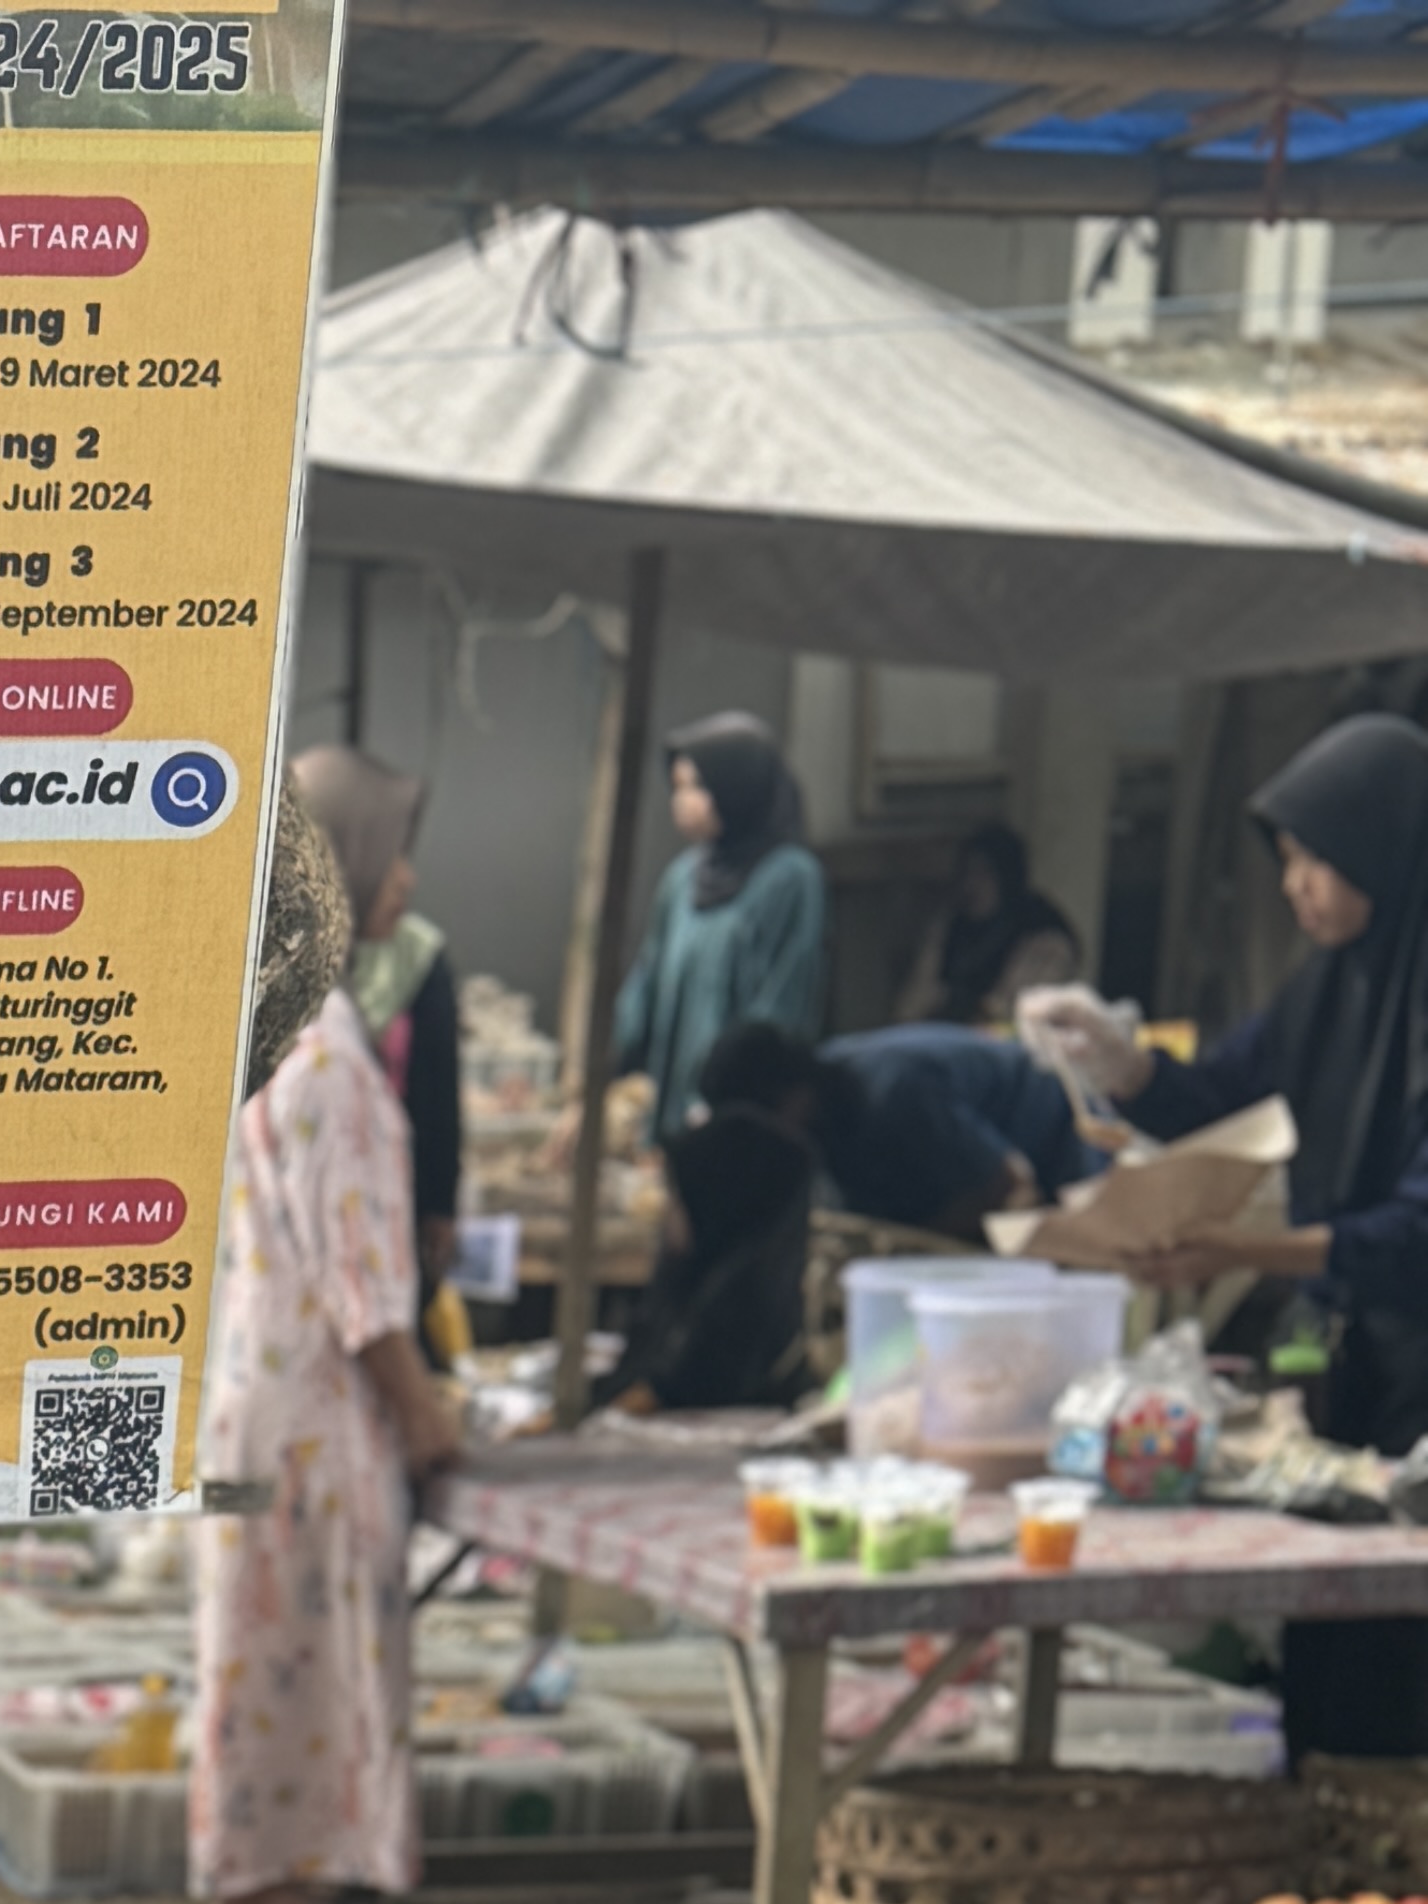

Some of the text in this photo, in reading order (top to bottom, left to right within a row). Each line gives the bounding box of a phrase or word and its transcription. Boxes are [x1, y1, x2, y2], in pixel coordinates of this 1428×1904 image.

[85, 304, 100, 335] 1
[30, 360, 129, 388] Maret
[137, 360, 221, 388] 2024
[76, 428, 100, 458] 2
[3, 483, 61, 511] Juli
[69, 483, 152, 511] 2024
[71, 546, 93, 576] 3
[176, 601, 257, 628] 2024
[3, 685, 116, 710] ONLINE
[45, 957, 87, 982] No
[95, 956, 113, 981] 1.
[72, 1031, 137, 1055] Kec.
[15, 1068, 168, 1094] Mataram,
[88, 1201, 174, 1224] KAMI
[35, 1304, 186, 1348] (admin)
